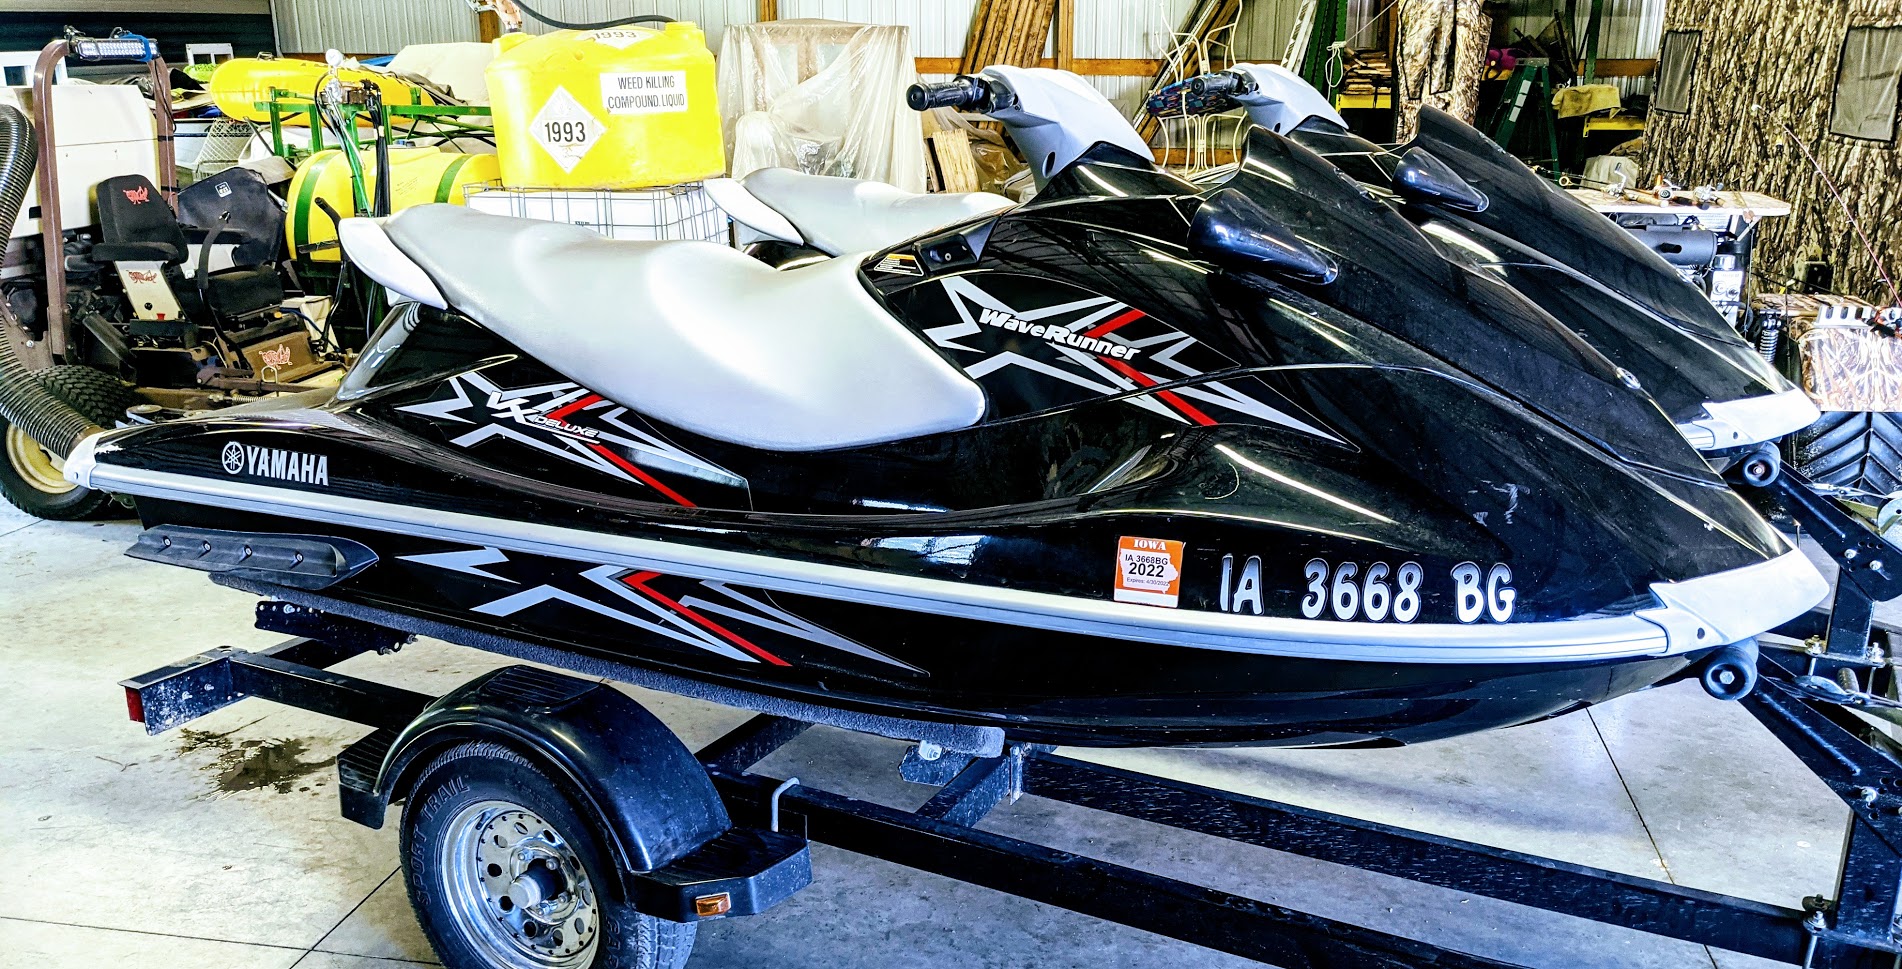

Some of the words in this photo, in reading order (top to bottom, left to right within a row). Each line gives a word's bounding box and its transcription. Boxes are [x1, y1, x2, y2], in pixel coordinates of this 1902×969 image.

[593, 31, 637, 40] 1993
[617, 77, 643, 90] WEED
[645, 75, 675, 89] KILLING
[661, 93, 685, 107] LIQUID
[544, 121, 586, 143] 1993
[978, 307, 1141, 361] WaveRunner
[486, 390, 539, 423] VX
[534, 415, 600, 438] DELUXE
[246, 445, 329, 487] YAMAHA
[1134, 539, 1166, 550] IOWA
[1128, 562, 1164, 577] 2022
[1136, 555, 1168, 565] 3668BG
[1219, 553, 1265, 615] IA
[1301, 557, 1424, 623] 3668
[1450, 560, 1517, 624] BG
[420, 776, 470, 822] TRAIL
[410, 823, 432, 906] SPORT
